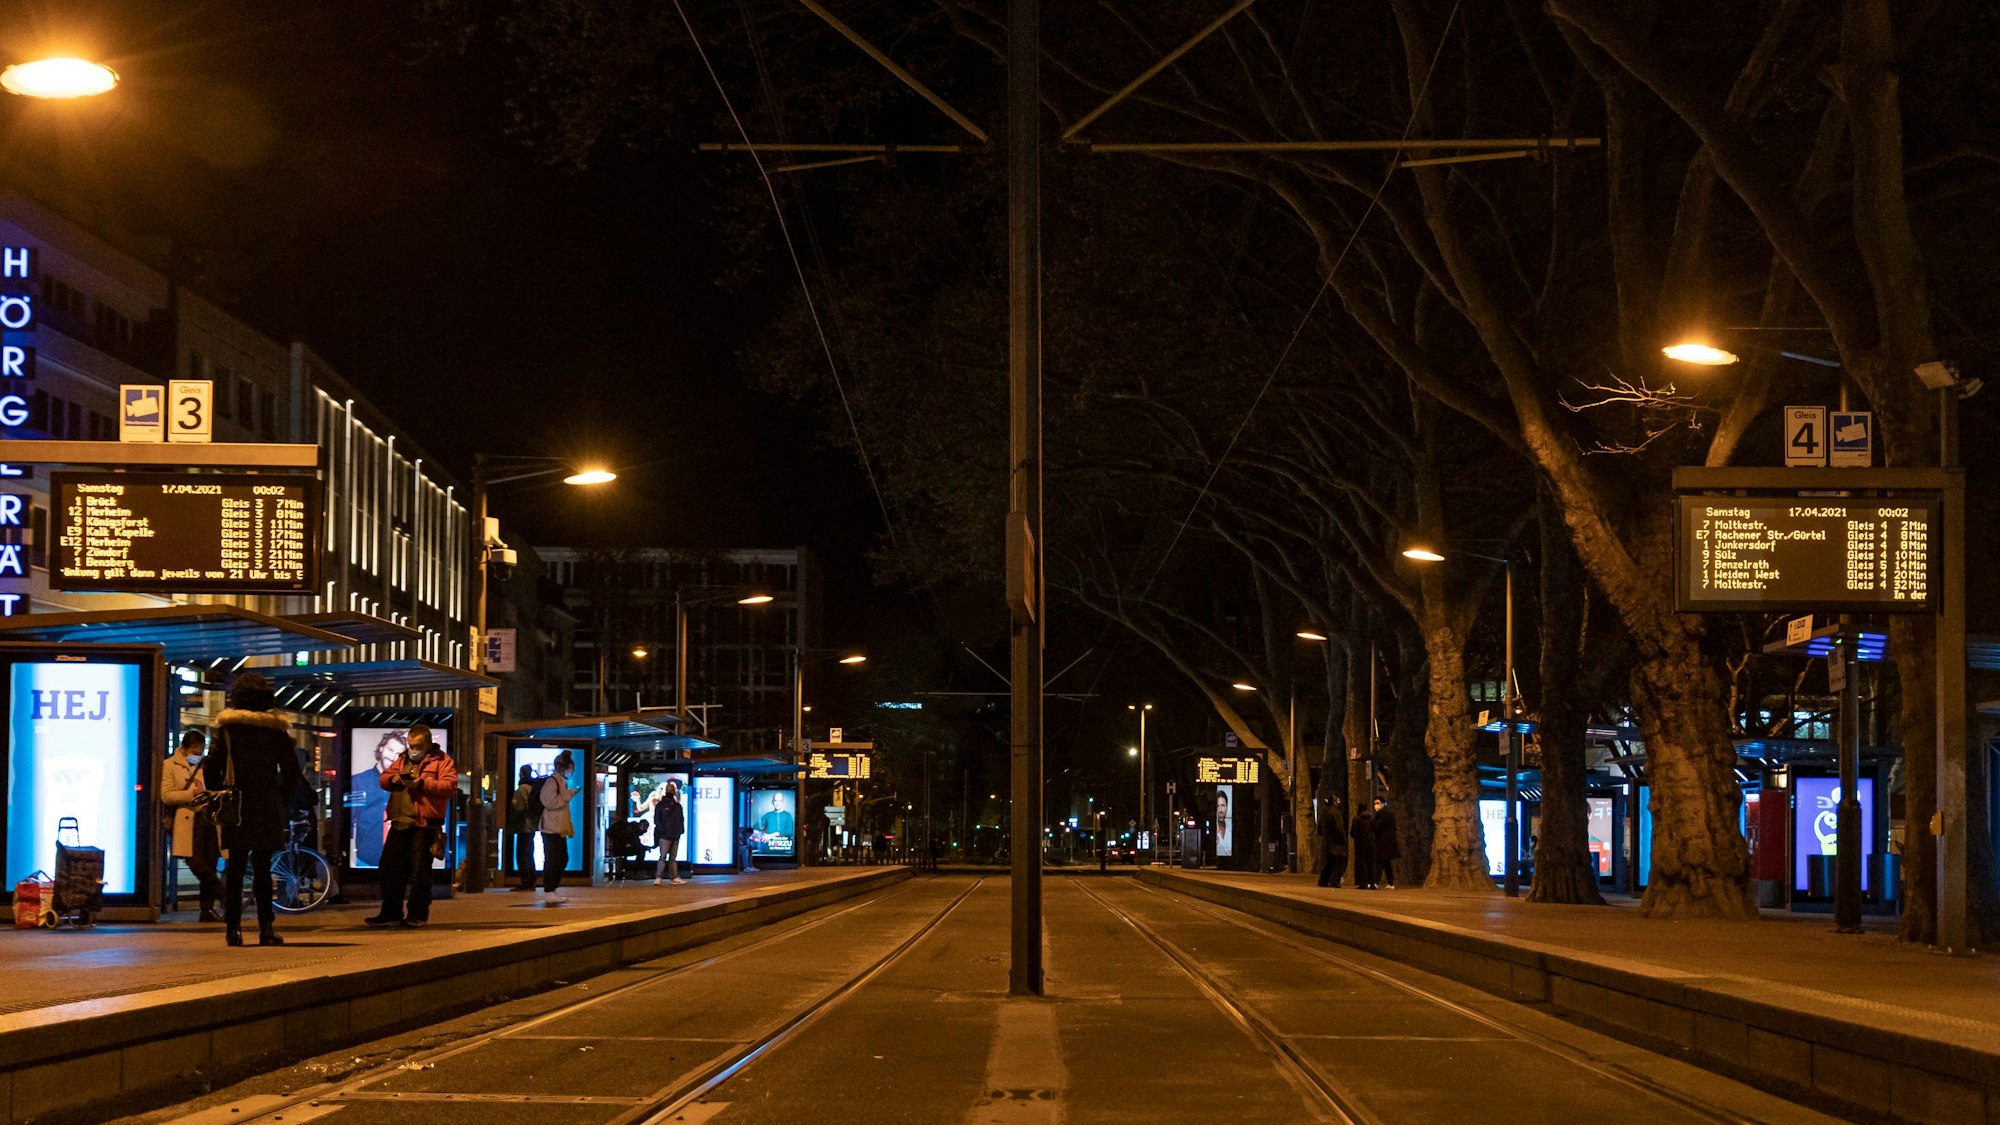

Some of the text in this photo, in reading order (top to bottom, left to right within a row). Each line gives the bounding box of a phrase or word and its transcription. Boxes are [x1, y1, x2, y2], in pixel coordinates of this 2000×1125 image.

[180, 386, 201, 394] Gleis
[178, 397, 202, 430] 3
[1794, 411, 1816, 419] Gleis
[1792, 422, 1819, 454] 4
[78, 484, 284, 495] Samstag 17.04.2021 00:02
[75, 497, 81, 506] 1
[87, 497, 117, 506] Brück
[222, 498, 249, 508] Gleis
[255, 498, 263, 508] 3
[68, 507, 82, 516] 12
[86, 507, 132, 516] Merheim
[222, 509, 249, 518] Gleis
[255, 509, 263, 518] 3
[1706, 508, 1908, 519] Samstag 17.04.2021 00:02
[74, 517, 81, 526] 9
[222, 519, 249, 528] Gleis
[255, 519, 263, 528] 3
[1703, 521, 1709, 529] 7
[1715, 521, 1767, 530] Moltkestr.
[1848, 521, 1874, 530] Gleis
[1880, 522, 1887, 530] 4
[67, 527, 81, 536] E9
[86, 527, 109, 536] Kalk
[114, 528, 154, 538] Kapelle
[222, 529, 249, 538] Gleis
[255, 529, 263, 538] 3
[1696, 530, 1709, 539] E7
[1715, 530, 1761, 539] Aachener
[1848, 531, 1874, 540] Gleis
[1880, 531, 1887, 540] 4
[61, 537, 82, 546] E12
[86, 537, 132, 546] Merheim
[222, 539, 249, 549] Gleis
[255, 539, 263, 549] 3
[1704, 540, 1708, 549] 1
[1715, 540, 1776, 552] Junkersdorf
[1848, 541, 1874, 550] Gleis
[1880, 542, 1887, 550] 4
[75, 547, 80, 556] 7
[222, 549, 249, 559] Gleis
[255, 549, 263, 559] 3
[1703, 550, 1709, 559] 9
[1715, 550, 1736, 559] Sülz
[1848, 551, 1874, 560] Gleis
[1880, 551, 1887, 560] 4
[75, 557, 81, 566] 1
[86, 557, 134, 568] Bensberg
[222, 559, 249, 569] Gleis
[255, 559, 263, 569] 3
[1703, 560, 1709, 569] 7
[1715, 560, 1769, 569] Benzelrath
[1848, 560, 1874, 569] Gleis
[1880, 561, 1887, 569] 5
[105, 569, 125, 580] gilt
[130, 569, 154, 578] dann
[160, 569, 200, 580] jeweils
[229, 570, 243, 579] 21
[249, 570, 267, 579] Uhr
[274, 570, 292, 579] bis
[1704, 570, 1708, 579] 1
[1715, 570, 1750, 579] Weiden
[1756, 570, 1780, 579] West
[1848, 570, 1874, 579] Gleis
[1880, 571, 1887, 579] 4
[1703, 580, 1709, 588] 7
[1715, 580, 1767, 589] Moltkestr.
[1848, 580, 1874, 589] Gleis
[1880, 581, 1887, 589] 4
[1894, 590, 1927, 599] In der
[694, 787, 722, 799] HEJ
[1166, 782, 1176, 794] H
